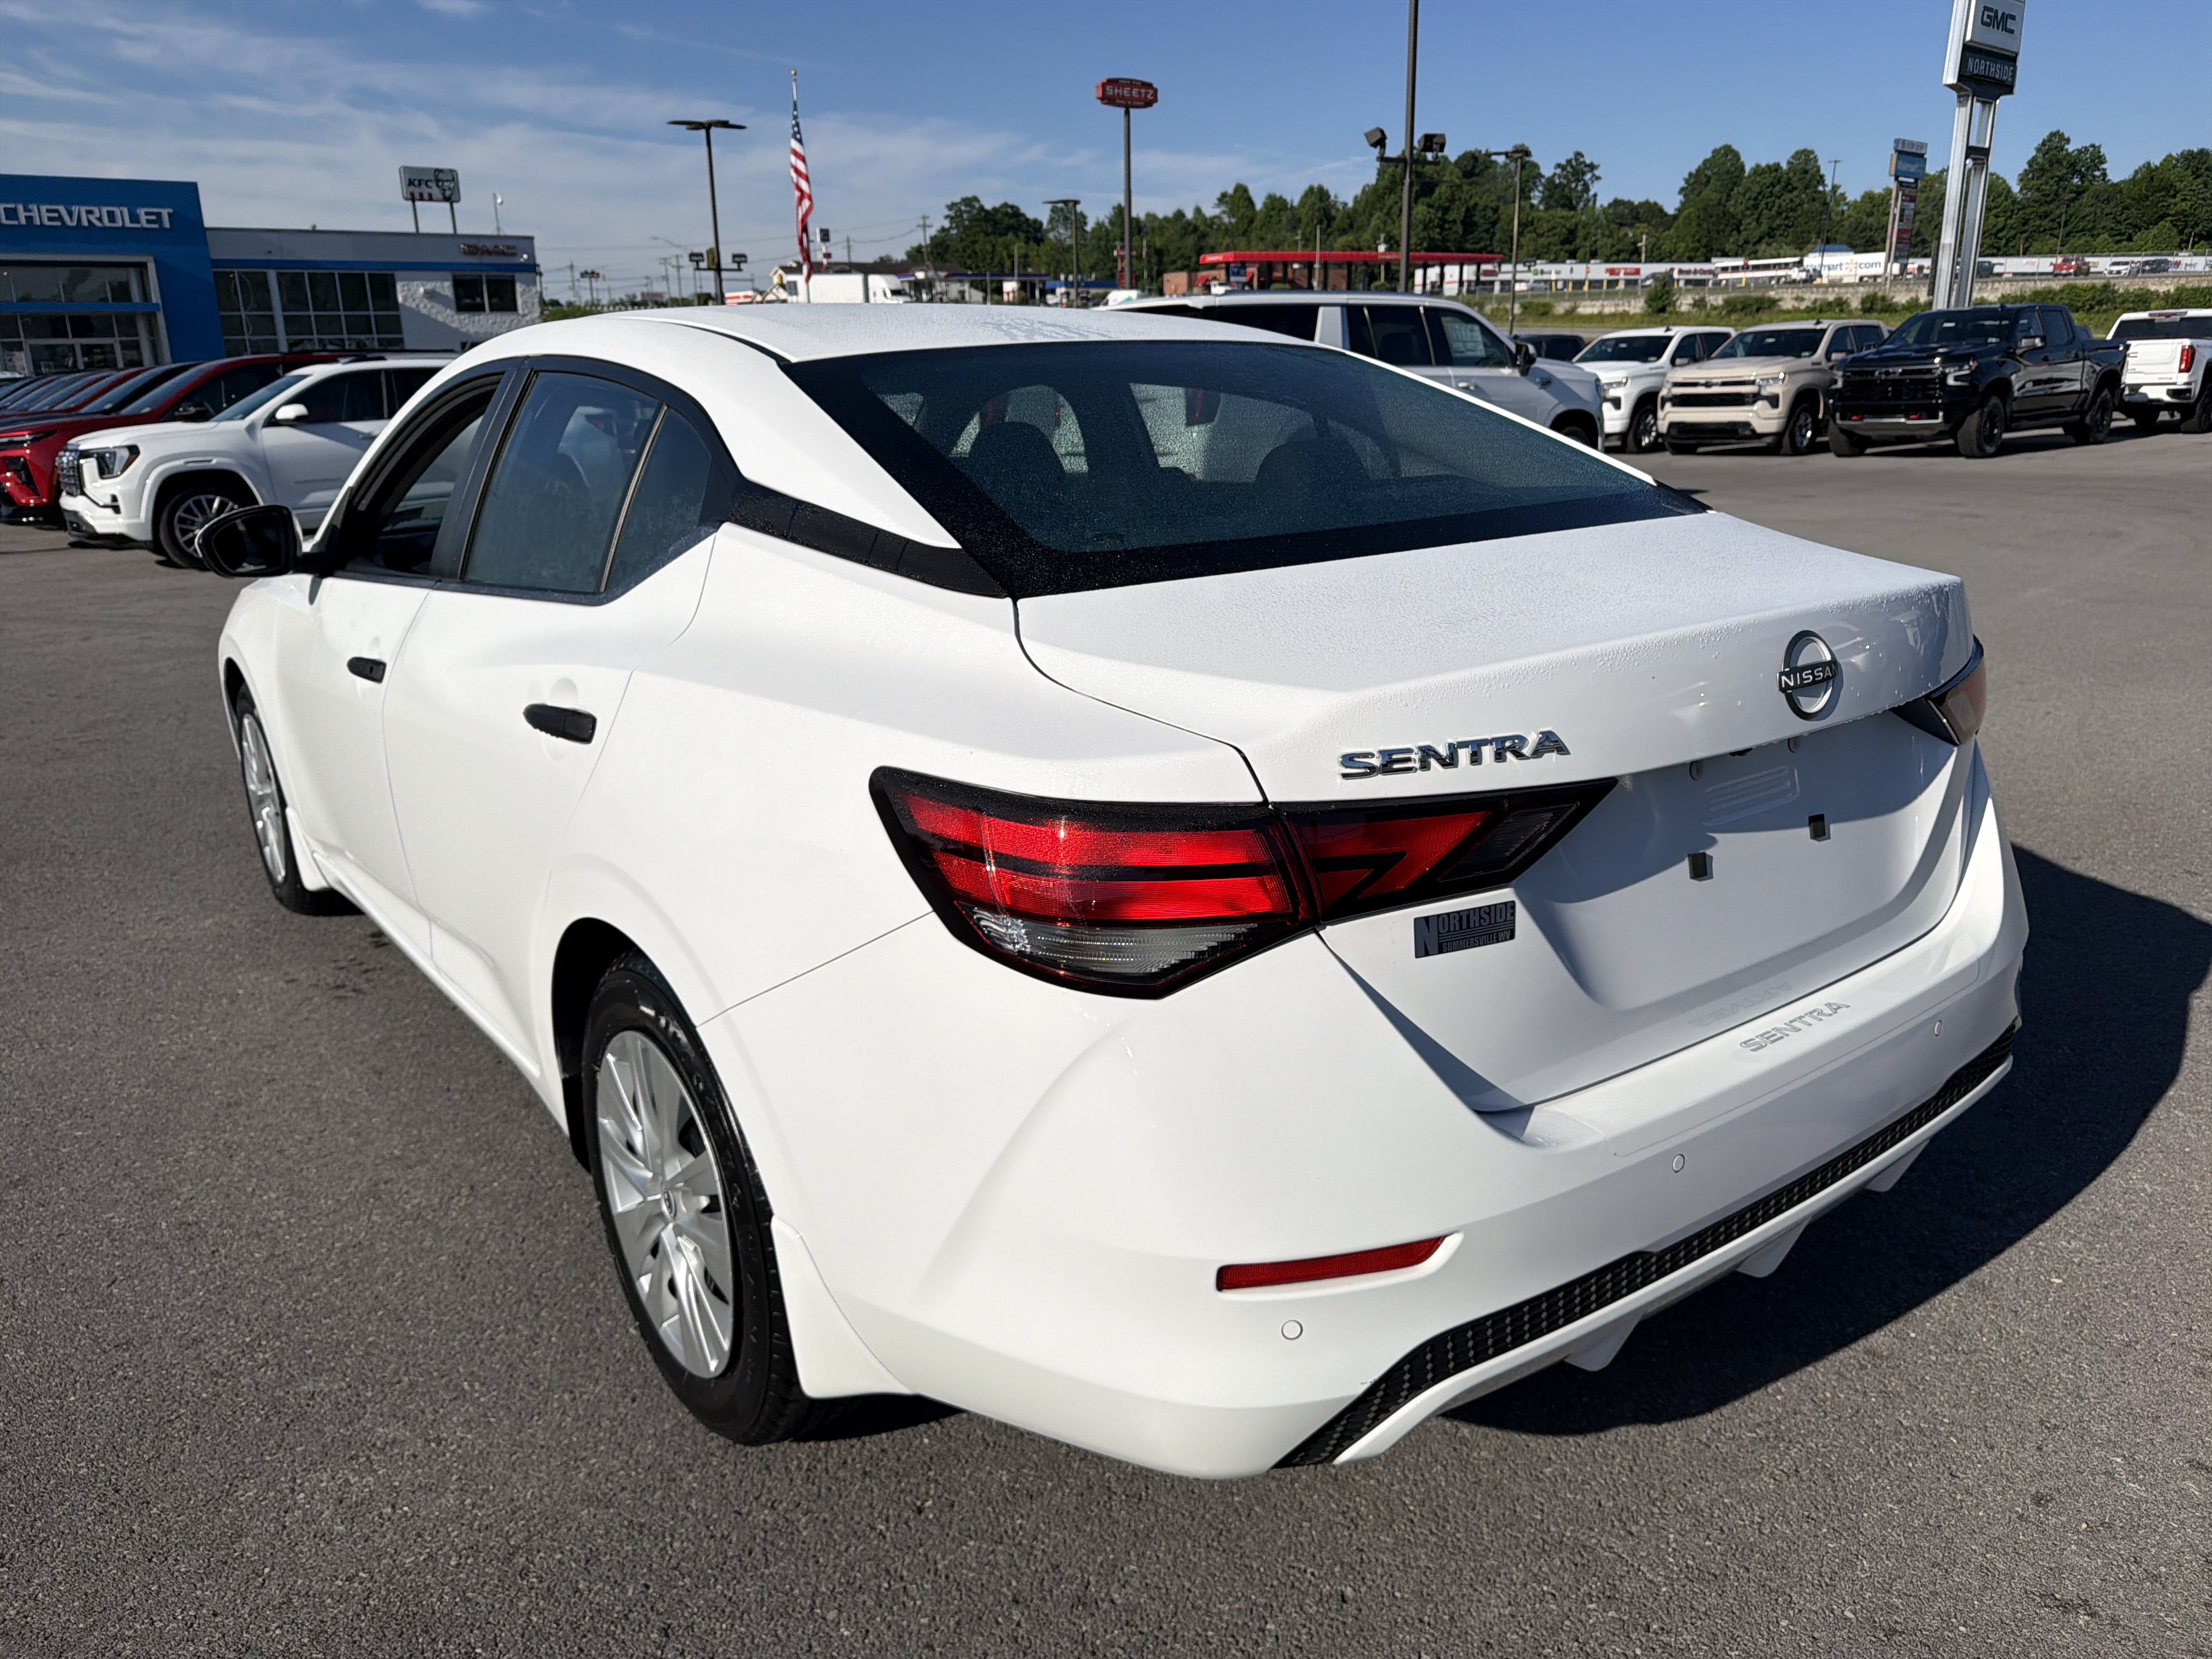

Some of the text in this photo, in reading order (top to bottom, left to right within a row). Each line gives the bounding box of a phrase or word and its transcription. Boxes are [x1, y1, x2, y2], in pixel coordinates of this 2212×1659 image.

[1980, 5, 2017, 35] GMC
[1967, 57, 2014, 81] NORTHSIDE
[1105, 85, 1154, 100] SHEETZ
[408, 178, 433, 189] KFC
[0, 203, 174, 229] CHEVROLET
[1858, 261, 1882, 270] com
[1339, 730, 1571, 780] SENTRA
[1414, 902, 1514, 957] NORTHSIDE
[1442, 930, 1512, 952] SUMMERSVILLE WV
[1740, 1002, 1850, 1052] SENTRA
